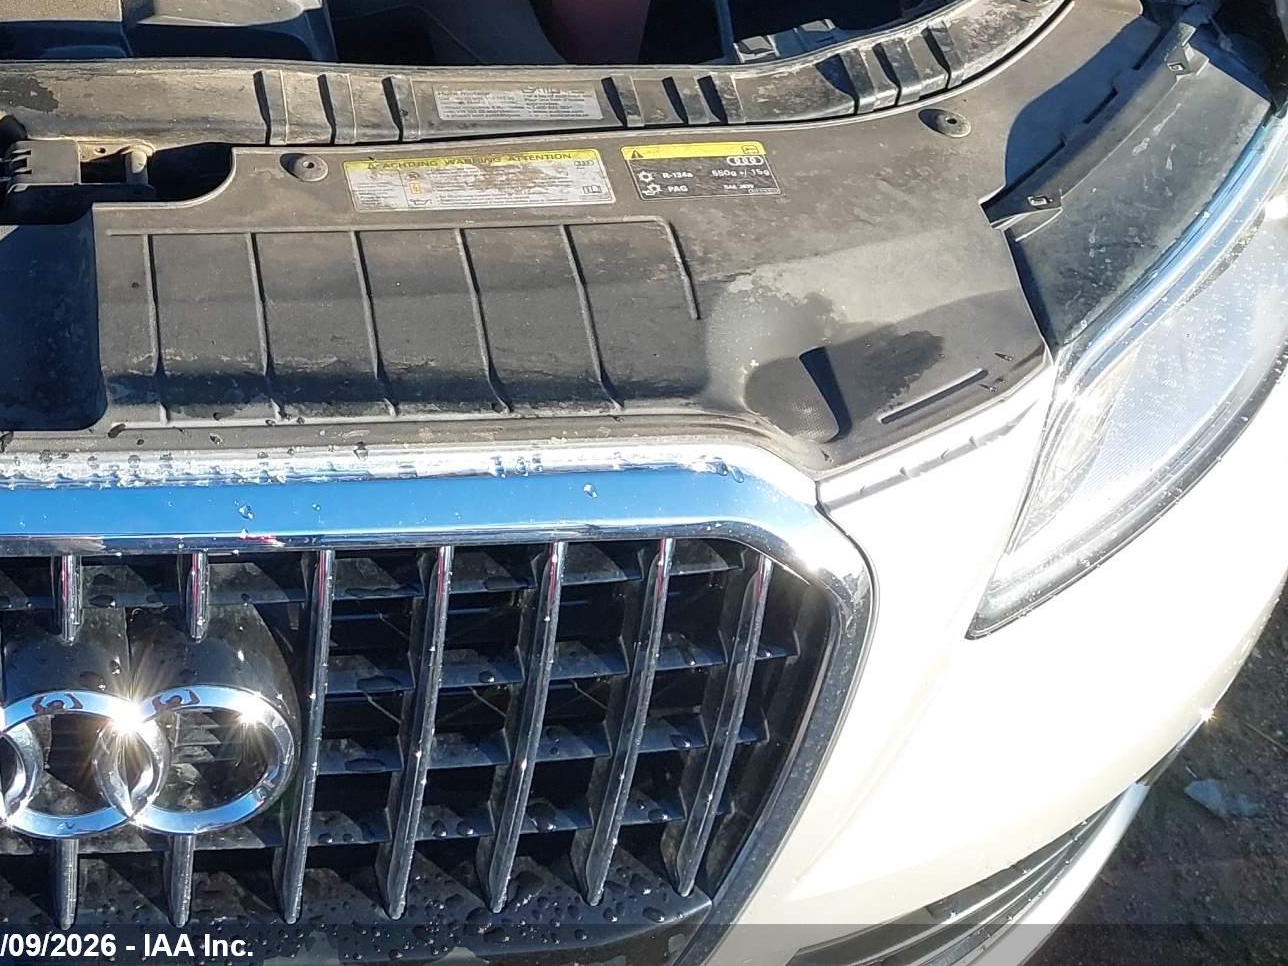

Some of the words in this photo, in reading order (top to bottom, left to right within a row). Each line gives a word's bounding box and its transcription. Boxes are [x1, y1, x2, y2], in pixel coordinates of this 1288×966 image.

[382, 160, 438, 169] ACHTUNG
[508, 153, 572, 161] ATTENTION
[662, 171, 694, 179] R-134a
[667, 185, 689, 193] PAG
